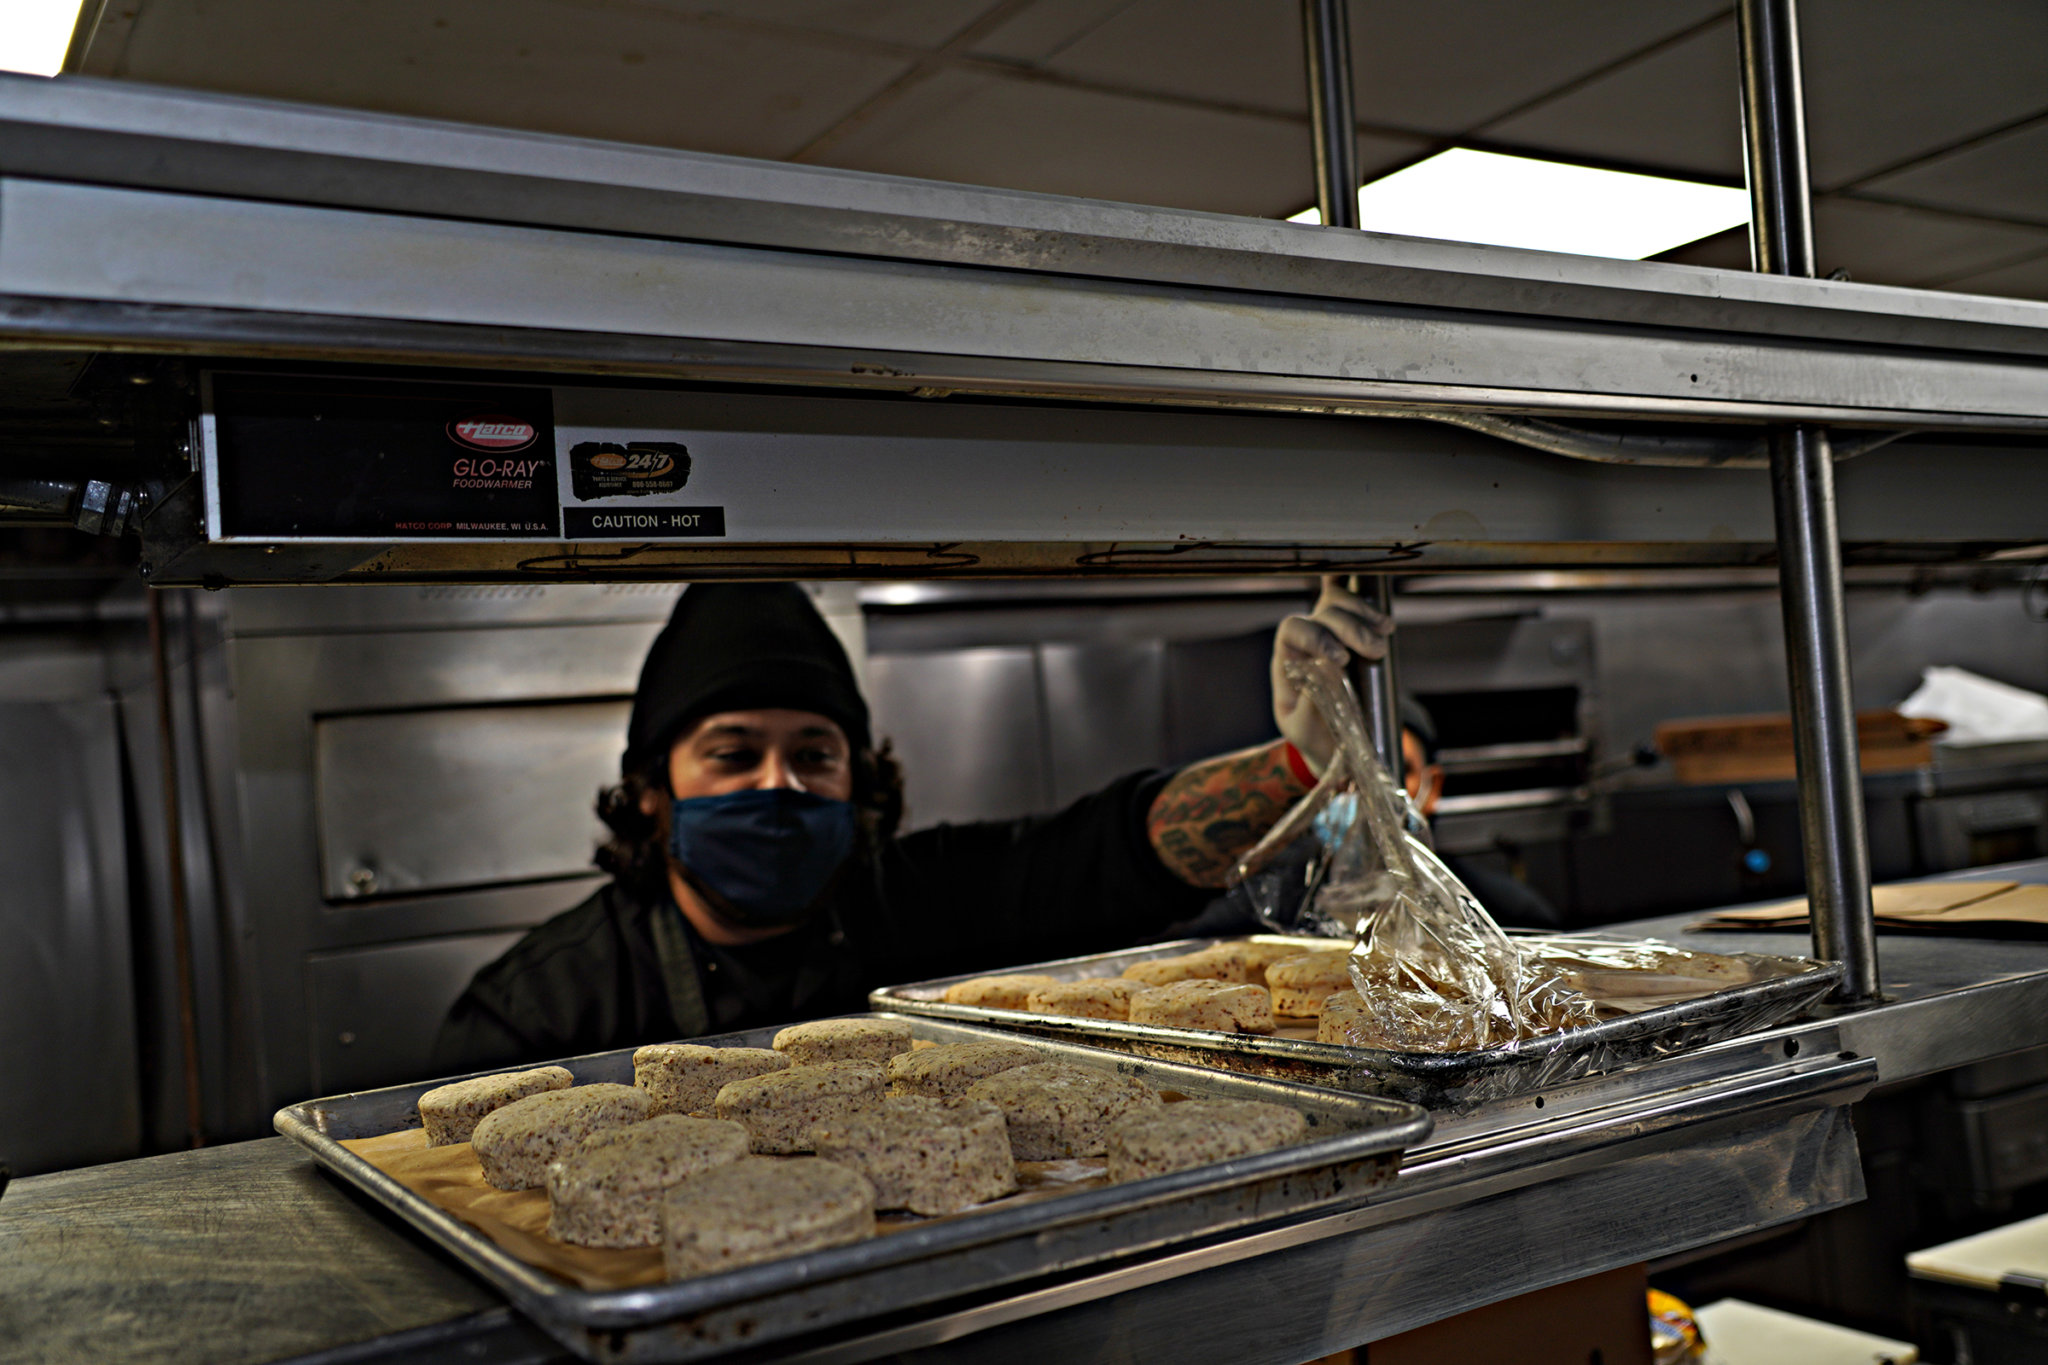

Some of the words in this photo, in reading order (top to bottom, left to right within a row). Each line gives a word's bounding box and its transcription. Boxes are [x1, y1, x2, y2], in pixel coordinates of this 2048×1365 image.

[458, 421, 529, 440] Hatco
[453, 478, 532, 489] FOODWARMER
[395, 522, 426, 530] HATCO
[511, 522, 522, 530] WI
[525, 522, 549, 530] U.S.A.
[592, 515, 658, 528] CAUTION
[671, 515, 701, 527] HOT
